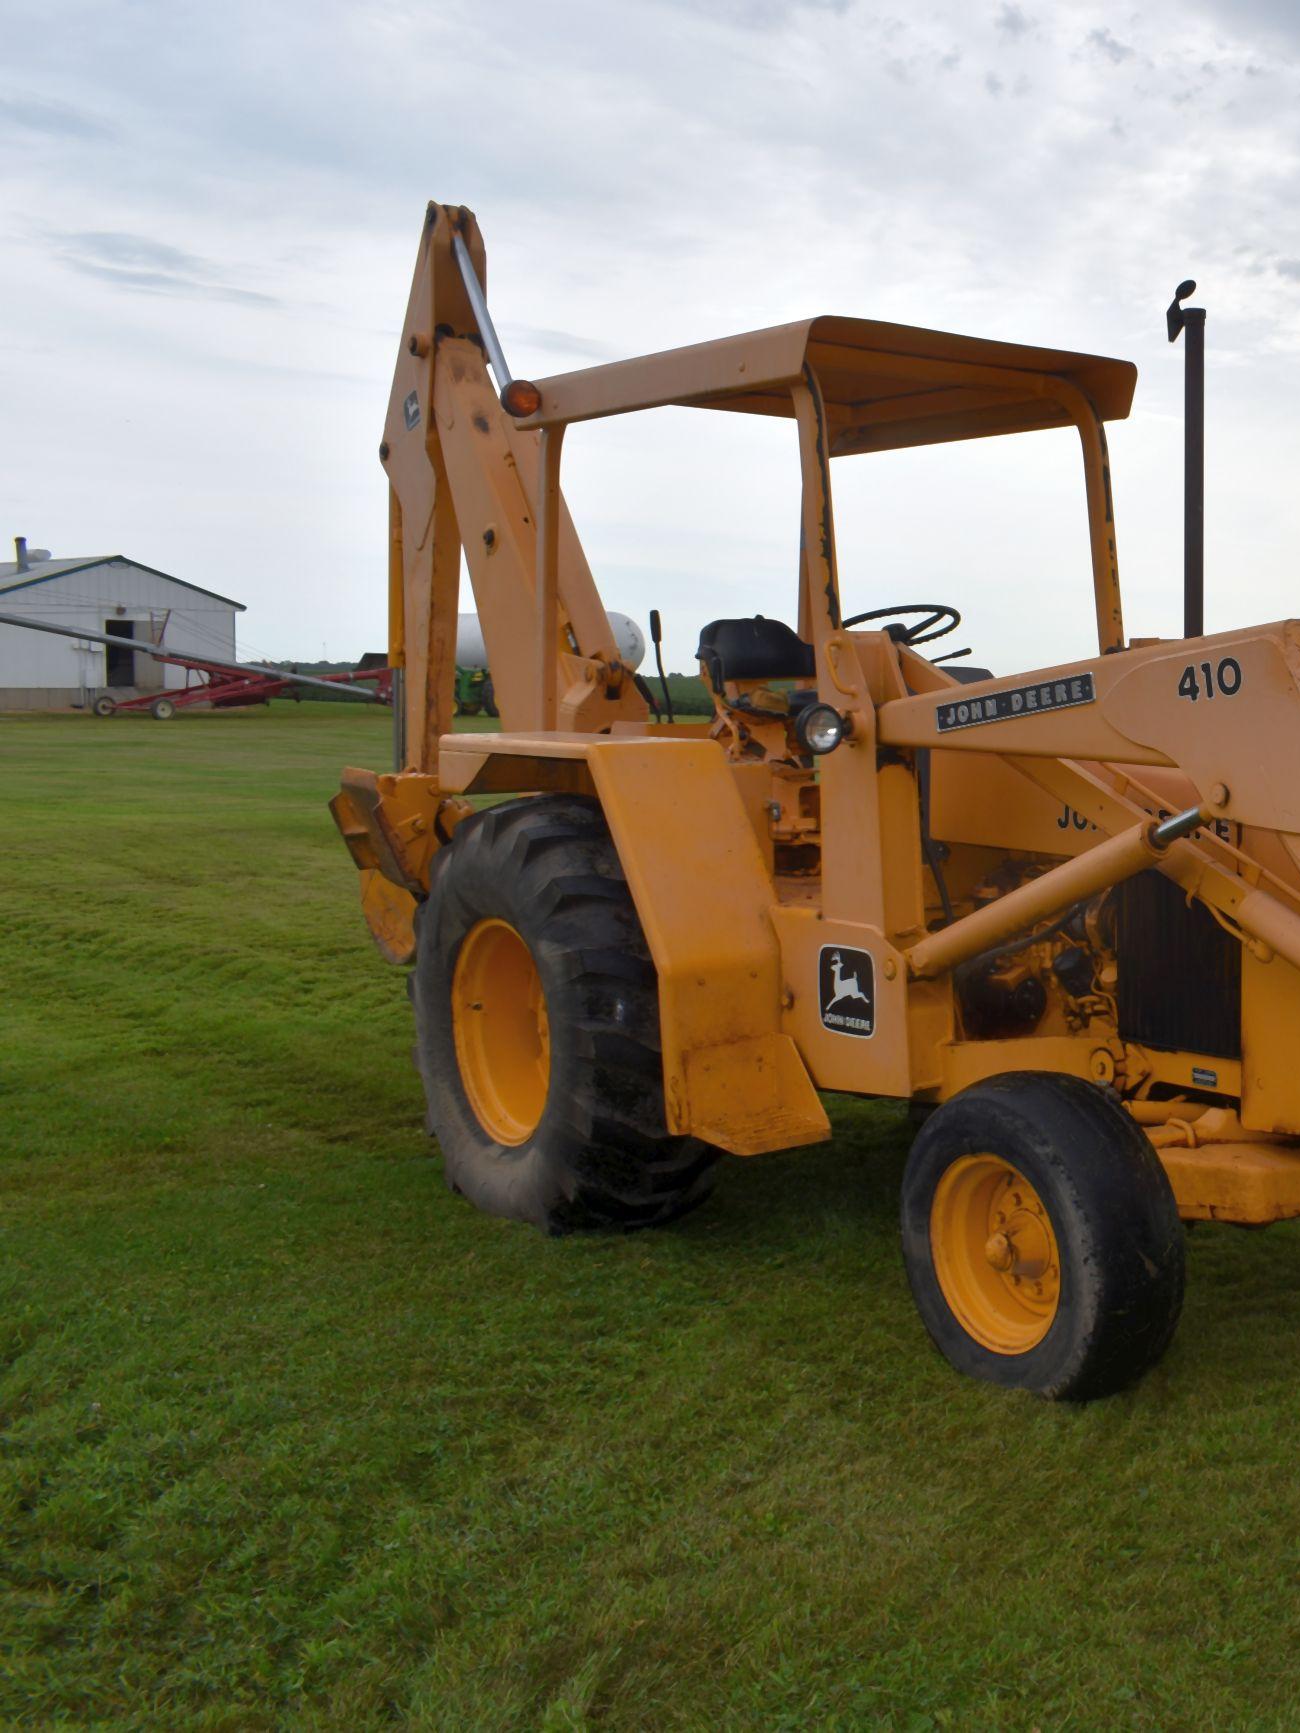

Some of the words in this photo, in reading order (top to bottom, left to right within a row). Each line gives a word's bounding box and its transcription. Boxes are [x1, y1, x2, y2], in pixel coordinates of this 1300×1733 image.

[1177, 657, 1242, 701] 410
[946, 698, 998, 725] JOHN
[1010, 680, 1083, 712] DEERE
